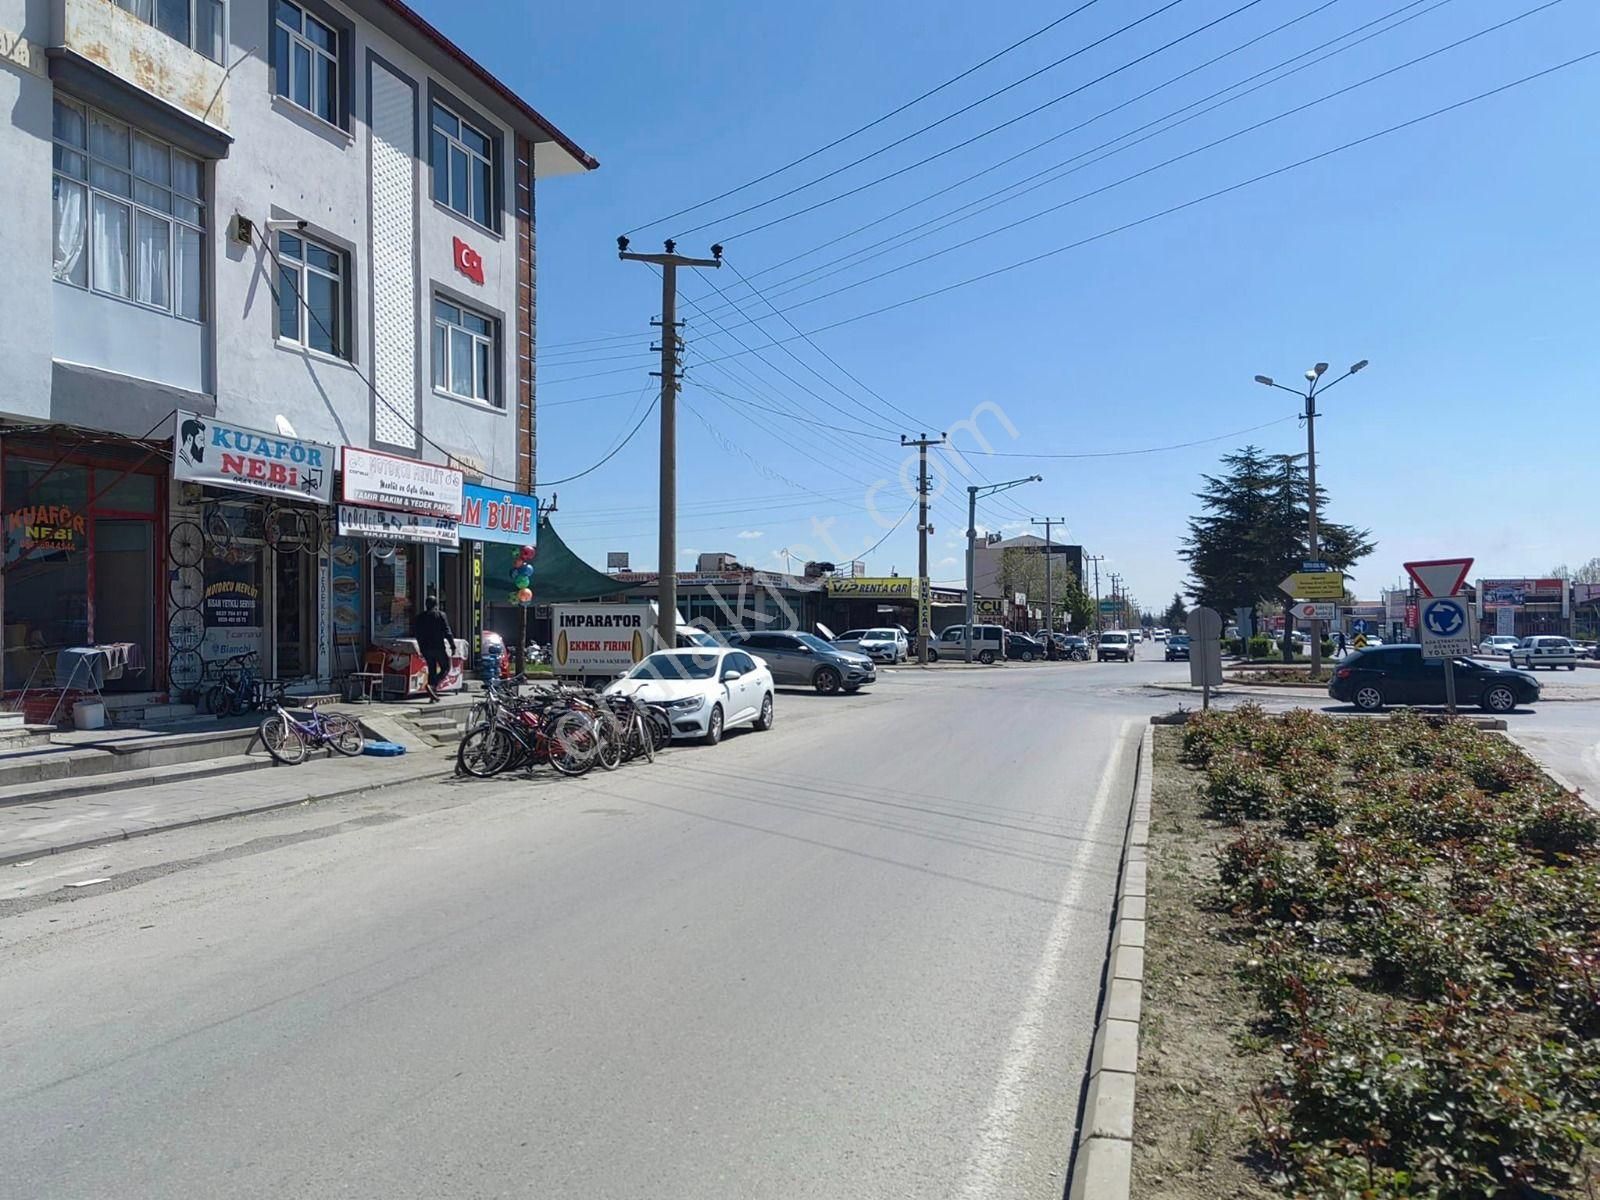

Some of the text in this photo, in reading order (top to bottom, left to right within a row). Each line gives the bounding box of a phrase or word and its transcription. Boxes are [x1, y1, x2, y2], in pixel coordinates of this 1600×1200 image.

[211, 426, 323, 466] KUAFÖR
[379, 493, 403, 505] BAKIM
[403, 497, 409, 506] &
[411, 499, 432, 510] YEDEK
[8, 504, 85, 536] KUAFÖR
[486, 495, 532, 534] BÜFE
[859, 583, 882, 593] RENT
[881, 583, 889, 593] A
[890, 583, 908, 593] CAR
[473, 558, 482, 653] BÜFE
[559, 611, 641, 627] İMPARATOR
[220, 643, 251, 654] Bianchi
[569, 640, 631, 651] EKMEK FIRINI
